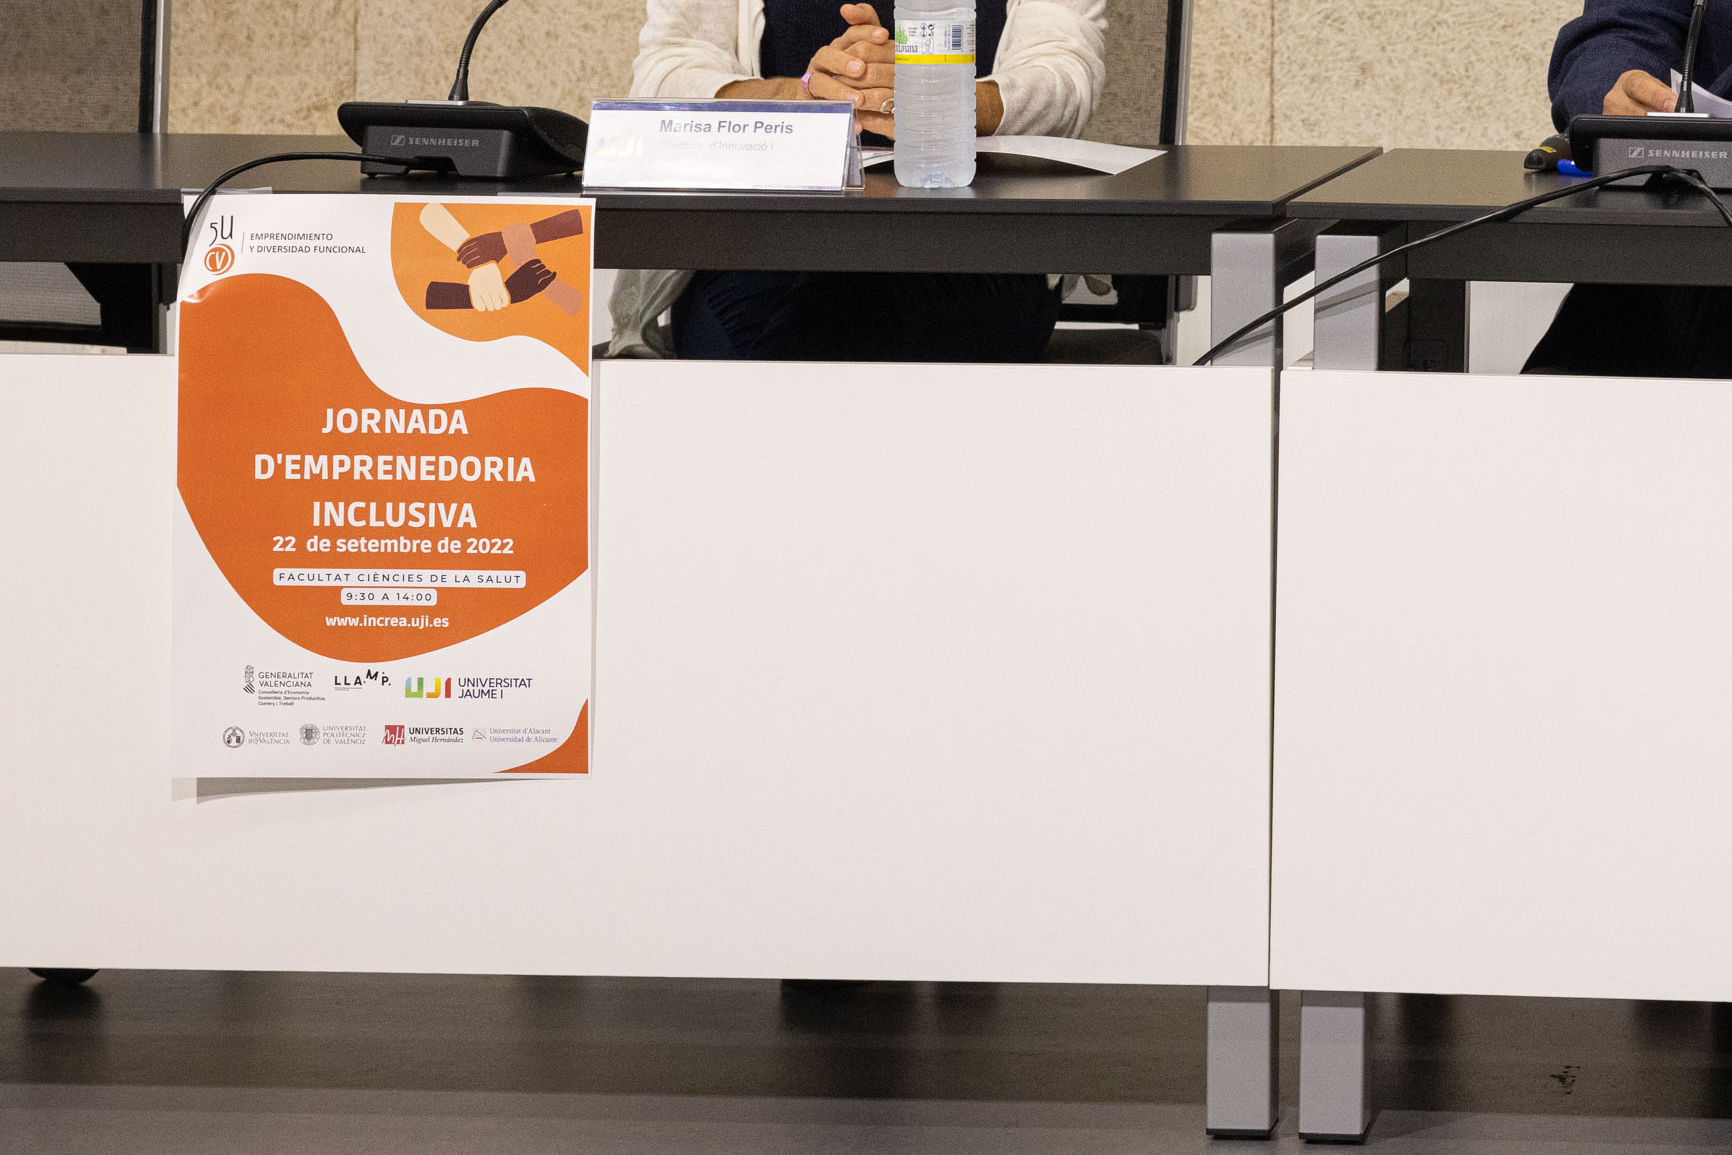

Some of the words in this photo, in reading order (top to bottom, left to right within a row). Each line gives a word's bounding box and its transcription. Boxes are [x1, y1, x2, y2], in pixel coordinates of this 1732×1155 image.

[659, 119, 712, 133] Marisa
[717, 121, 748, 134] Flor
[754, 121, 794, 134] Peris
[408, 137, 480, 147] SENNHEISER
[1647, 149, 1728, 159] SENNHEISER
[250, 233, 333, 241] EMPRENDIMIENTO
[313, 246, 366, 254] FUNCIONAL
[322, 408, 468, 435] JORNADA
[254, 454, 535, 482] D'EMPRENEDORIA
[313, 501, 477, 528] INCLUSIVA
[273, 536, 297, 552] 22
[307, 535, 330, 553] de
[336, 536, 432, 554] setembre
[437, 537, 461, 554] de
[466, 538, 514, 554] 2022
[279, 572, 351, 582] FACULTAT
[357, 571, 424, 583] CIÈNCIES
[430, 574, 449, 583] DE
[455, 575, 471, 584] LA
[477, 575, 522, 584] SALUT
[346, 592, 376, 602] 9:30
[381, 592, 391, 602] A
[396, 592, 433, 603] 14:00
[325, 614, 449, 630] www.increa.uji.es
[405, 677, 452, 698] UJI
[458, 678, 533, 688] UNIVERSITAT
[458, 689, 497, 699] JAUME
[500, 690, 503, 699] I
[408, 727, 464, 735] UNIVERSITAS
[409, 736, 430, 744] Miguel
